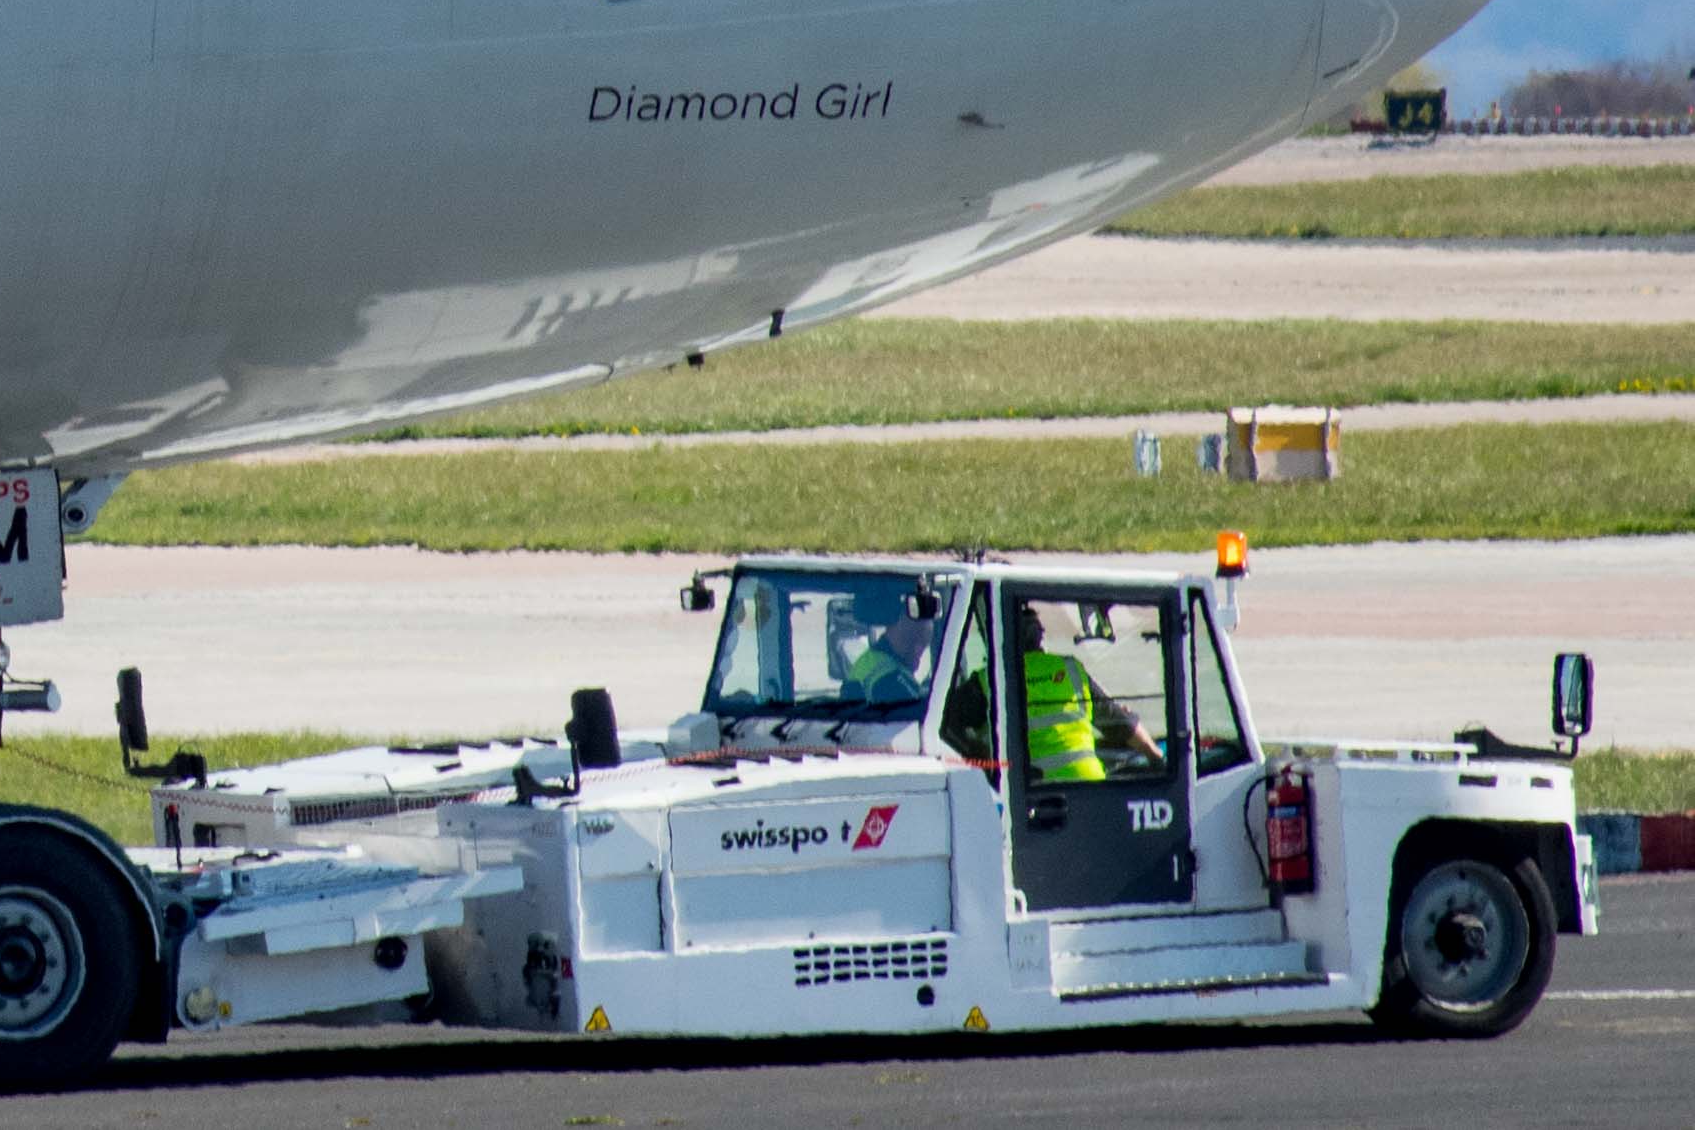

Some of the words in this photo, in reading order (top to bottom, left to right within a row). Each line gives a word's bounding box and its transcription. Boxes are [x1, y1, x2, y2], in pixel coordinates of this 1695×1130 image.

[589, 82, 800, 121] Diamond
[815, 81, 893, 120] Girl
[1127, 800, 1173, 832] TLD
[721, 819, 851, 854] swisspot
